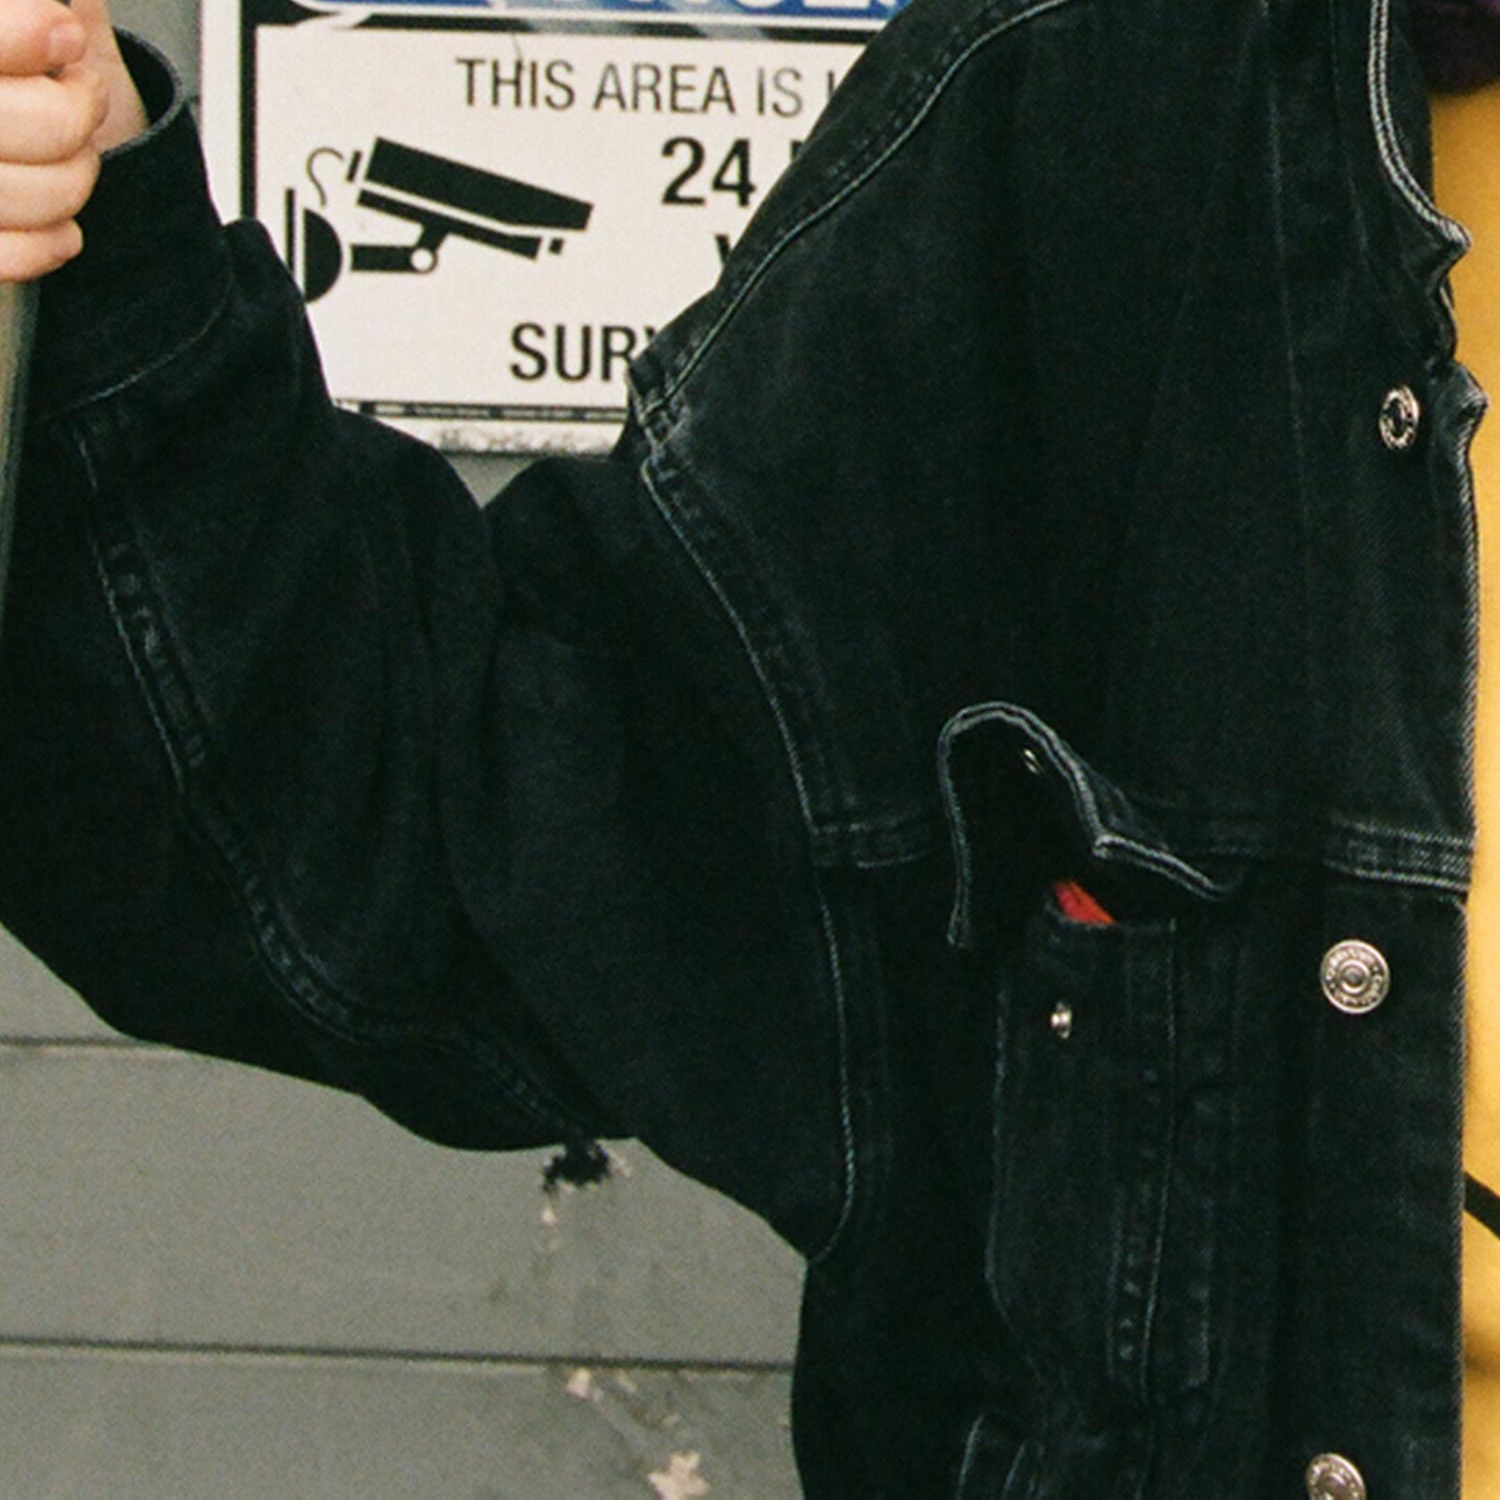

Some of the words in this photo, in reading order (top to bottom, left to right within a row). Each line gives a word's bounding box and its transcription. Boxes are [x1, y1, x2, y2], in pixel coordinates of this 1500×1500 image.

[455, 56, 576, 111] THIS
[592, 62, 737, 115] AREA
[756, 67, 803, 118] IS
[660, 136, 757, 208] 24
[509, 322, 656, 383] SUR
